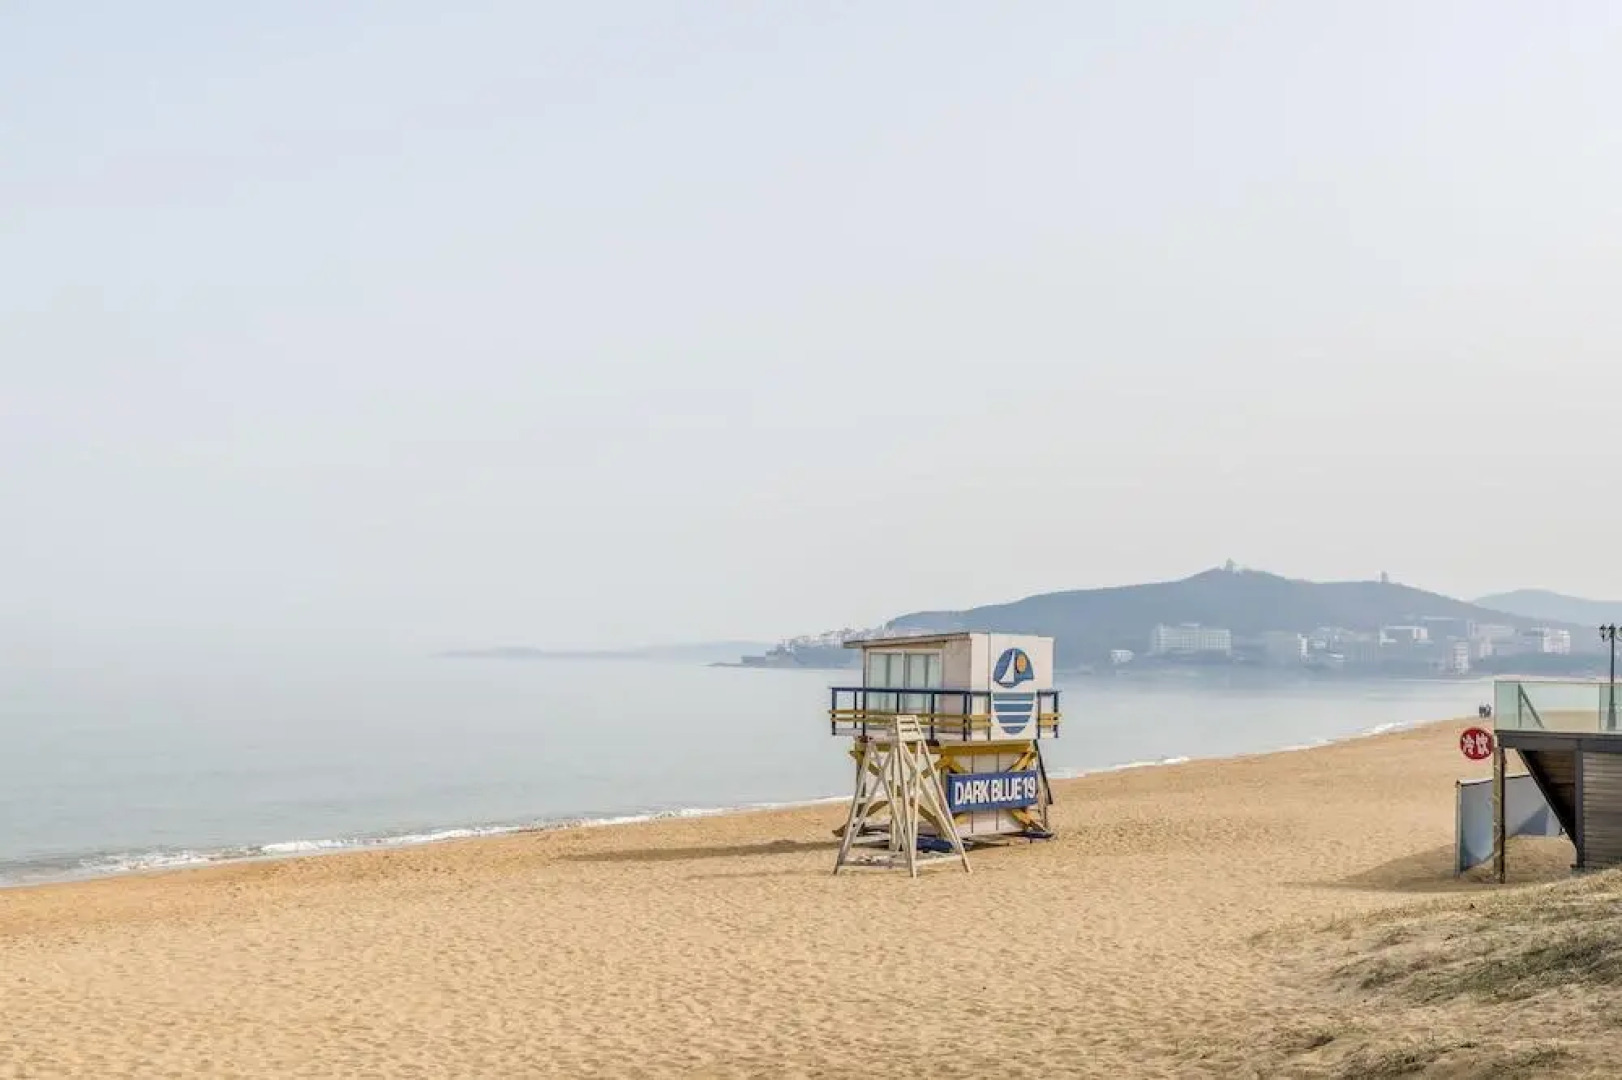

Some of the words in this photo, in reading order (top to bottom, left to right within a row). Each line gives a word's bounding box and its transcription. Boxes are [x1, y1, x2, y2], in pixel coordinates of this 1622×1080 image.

[954, 779, 990, 805] DARK
[991, 777, 1022, 802] BLUE
[1022, 776, 1036, 799] 19
